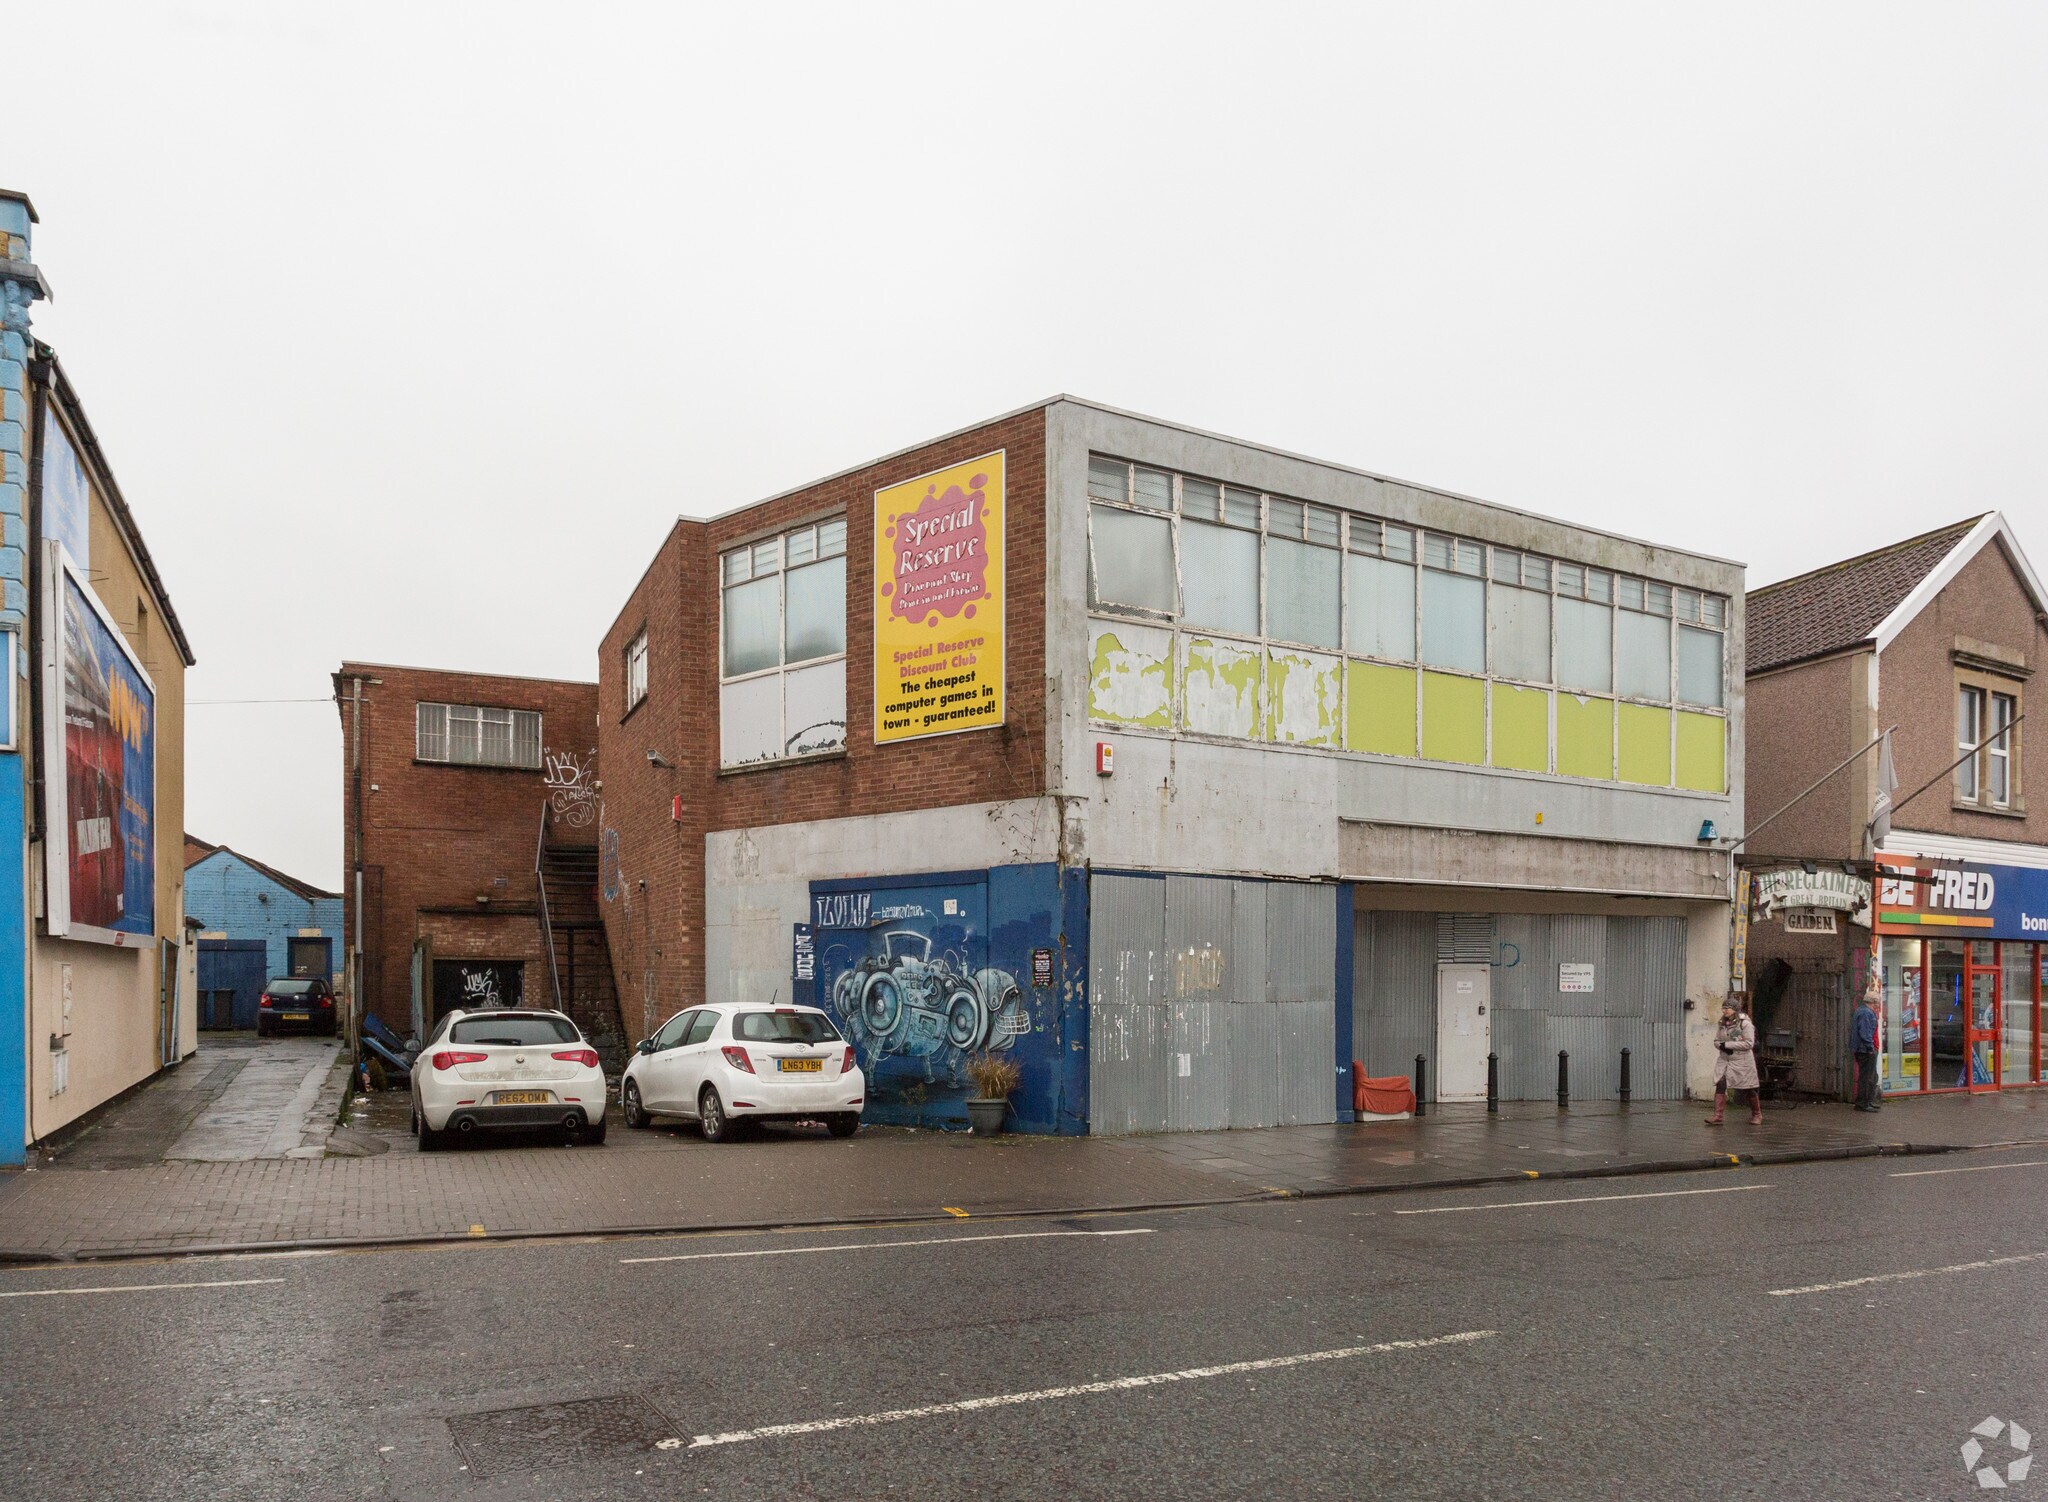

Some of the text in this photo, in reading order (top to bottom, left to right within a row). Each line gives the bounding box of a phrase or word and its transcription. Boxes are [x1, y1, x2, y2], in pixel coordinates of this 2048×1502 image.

[905, 499, 975, 547] Special
[900, 536, 979, 575] Reserve
[904, 570, 972, 595] Discount Shop
[922, 595, 931, 604] in
[932, 588, 950, 602] and
[951, 584, 980, 597] browse
[893, 636, 985, 664] Special Reserve
[900, 653, 977, 678] Discount Club
[901, 671, 976, 694] The cheapest
[885, 685, 993, 713] computer games in
[883, 718, 910, 730] town
[923, 700, 996, 727] guaranteed!
[1785, 870, 1872, 901] RECLAIMERS
[1790, 894, 1814, 905] GREAT
[1819, 894, 1848, 909] BRITAIN
[1804, 906, 1816, 915] THE
[1736, 872, 1748, 977] VINTAGE
[1788, 914, 1834, 930] GARDEN
[782, 1061, 804, 1070] LN63
[805, 1060, 822, 1069] YBH
[498, 1093, 526, 1103] RE62
